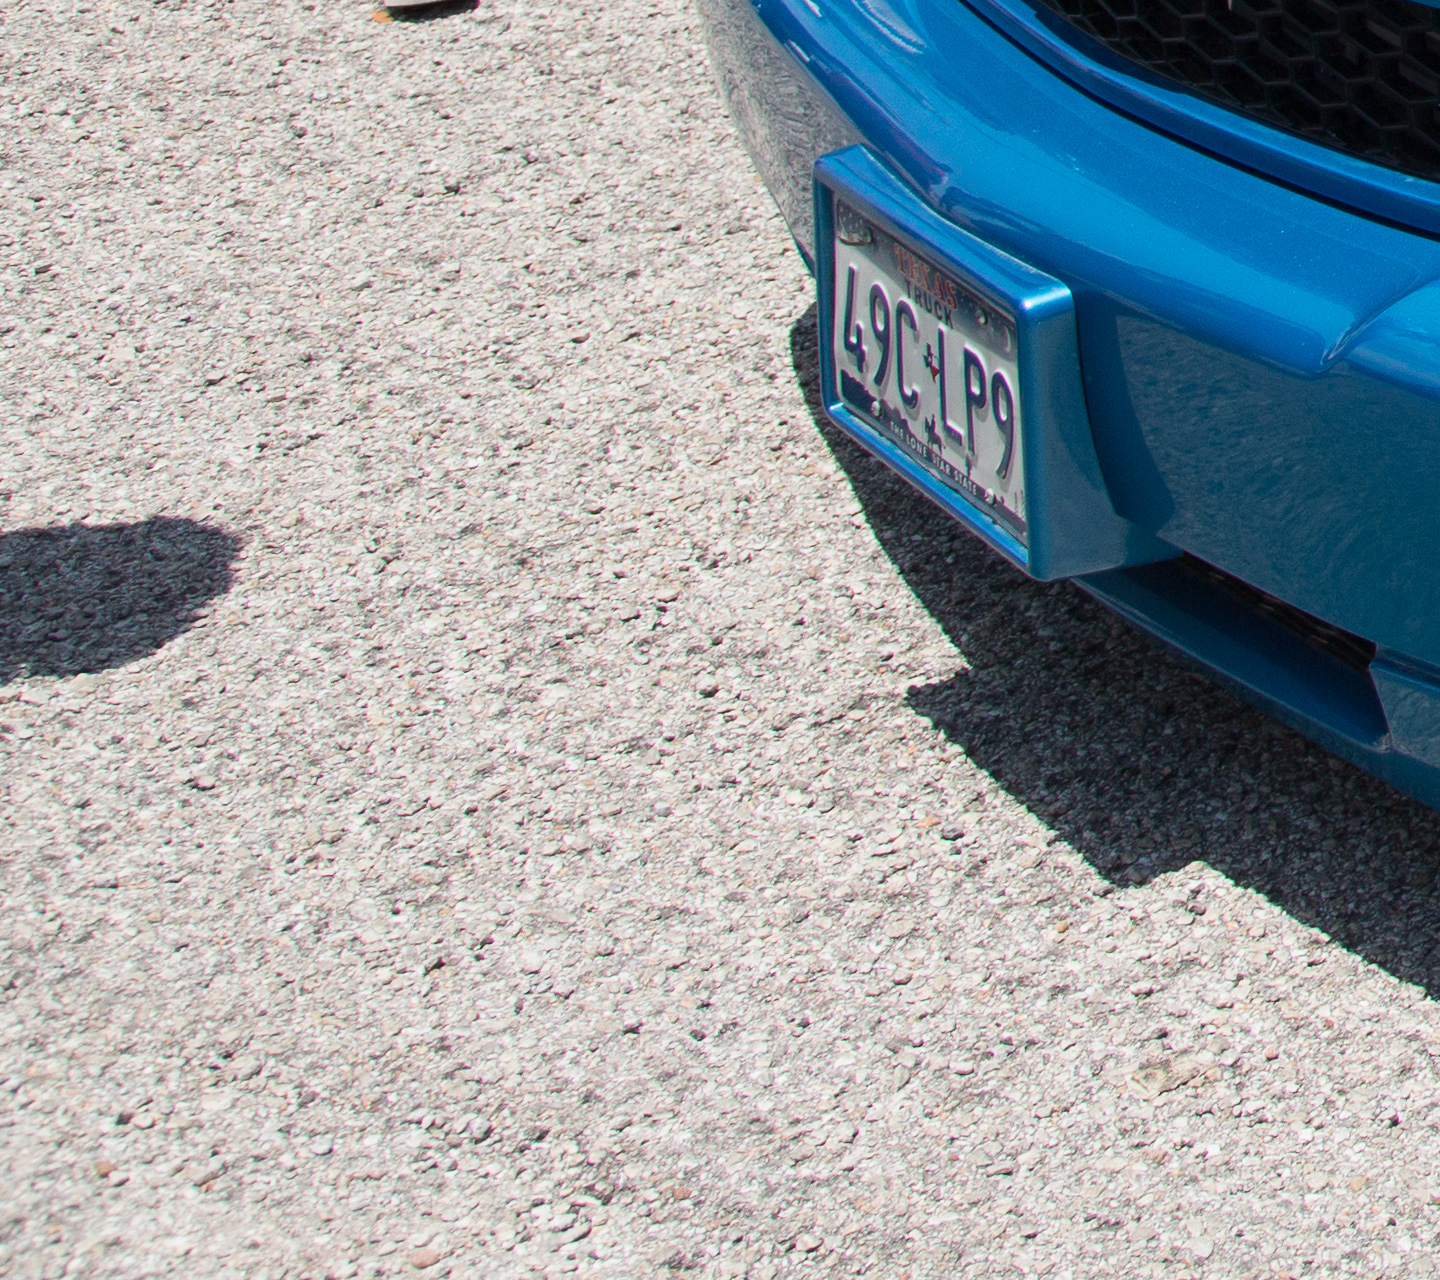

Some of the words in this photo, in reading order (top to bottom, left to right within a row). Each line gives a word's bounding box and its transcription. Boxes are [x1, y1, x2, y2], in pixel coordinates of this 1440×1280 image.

[893, 243, 958, 310] TEXAS
[906, 278, 954, 330] TRUCK
[890, 421, 904, 440] THE
[906, 434, 927, 458] LONE
[932, 457, 951, 476] STAR
[954, 470, 977, 496] STATE
